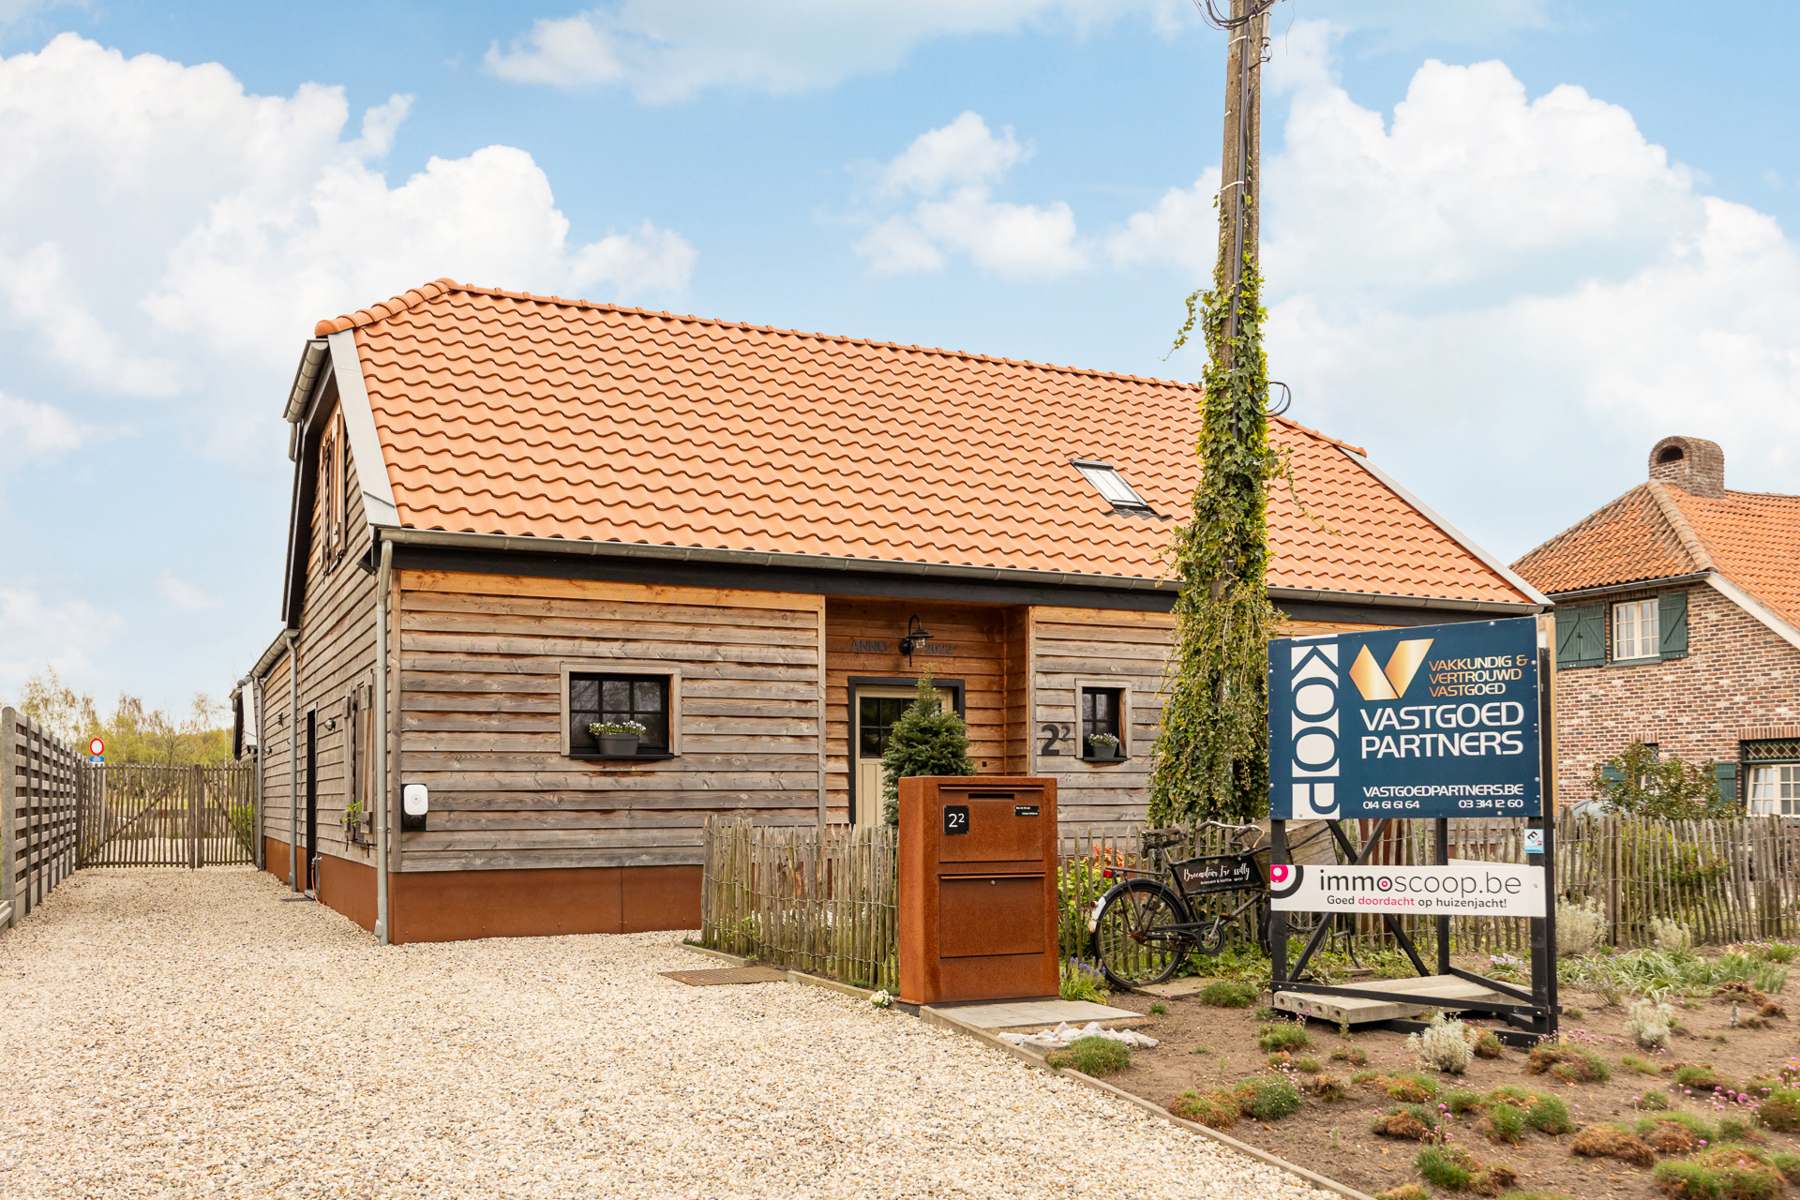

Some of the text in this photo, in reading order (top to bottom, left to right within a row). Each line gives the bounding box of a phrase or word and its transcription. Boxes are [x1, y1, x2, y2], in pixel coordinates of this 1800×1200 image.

[851, 639, 954, 655] ANNO 2022
[1428, 654, 1529, 671] VAKKUNDIG &
[1428, 668, 1522, 684] VERTROUWD
[1428, 682, 1506, 697] VASTGOED
[1359, 701, 1525, 731] VASTGOED
[1291, 638, 1340, 818] KOOP
[1361, 730, 1524, 759] PARTNERS
[1363, 784, 1524, 797] VASTGOEDPARTNERS.BE
[1363, 800, 1420, 809] 014 61 61 64
[1458, 799, 1524, 808] 03 314 12 60
[1320, 869, 1521, 898] immoscoop.be
[1327, 895, 1507, 909] Goed doordacht op huizenjacht!
